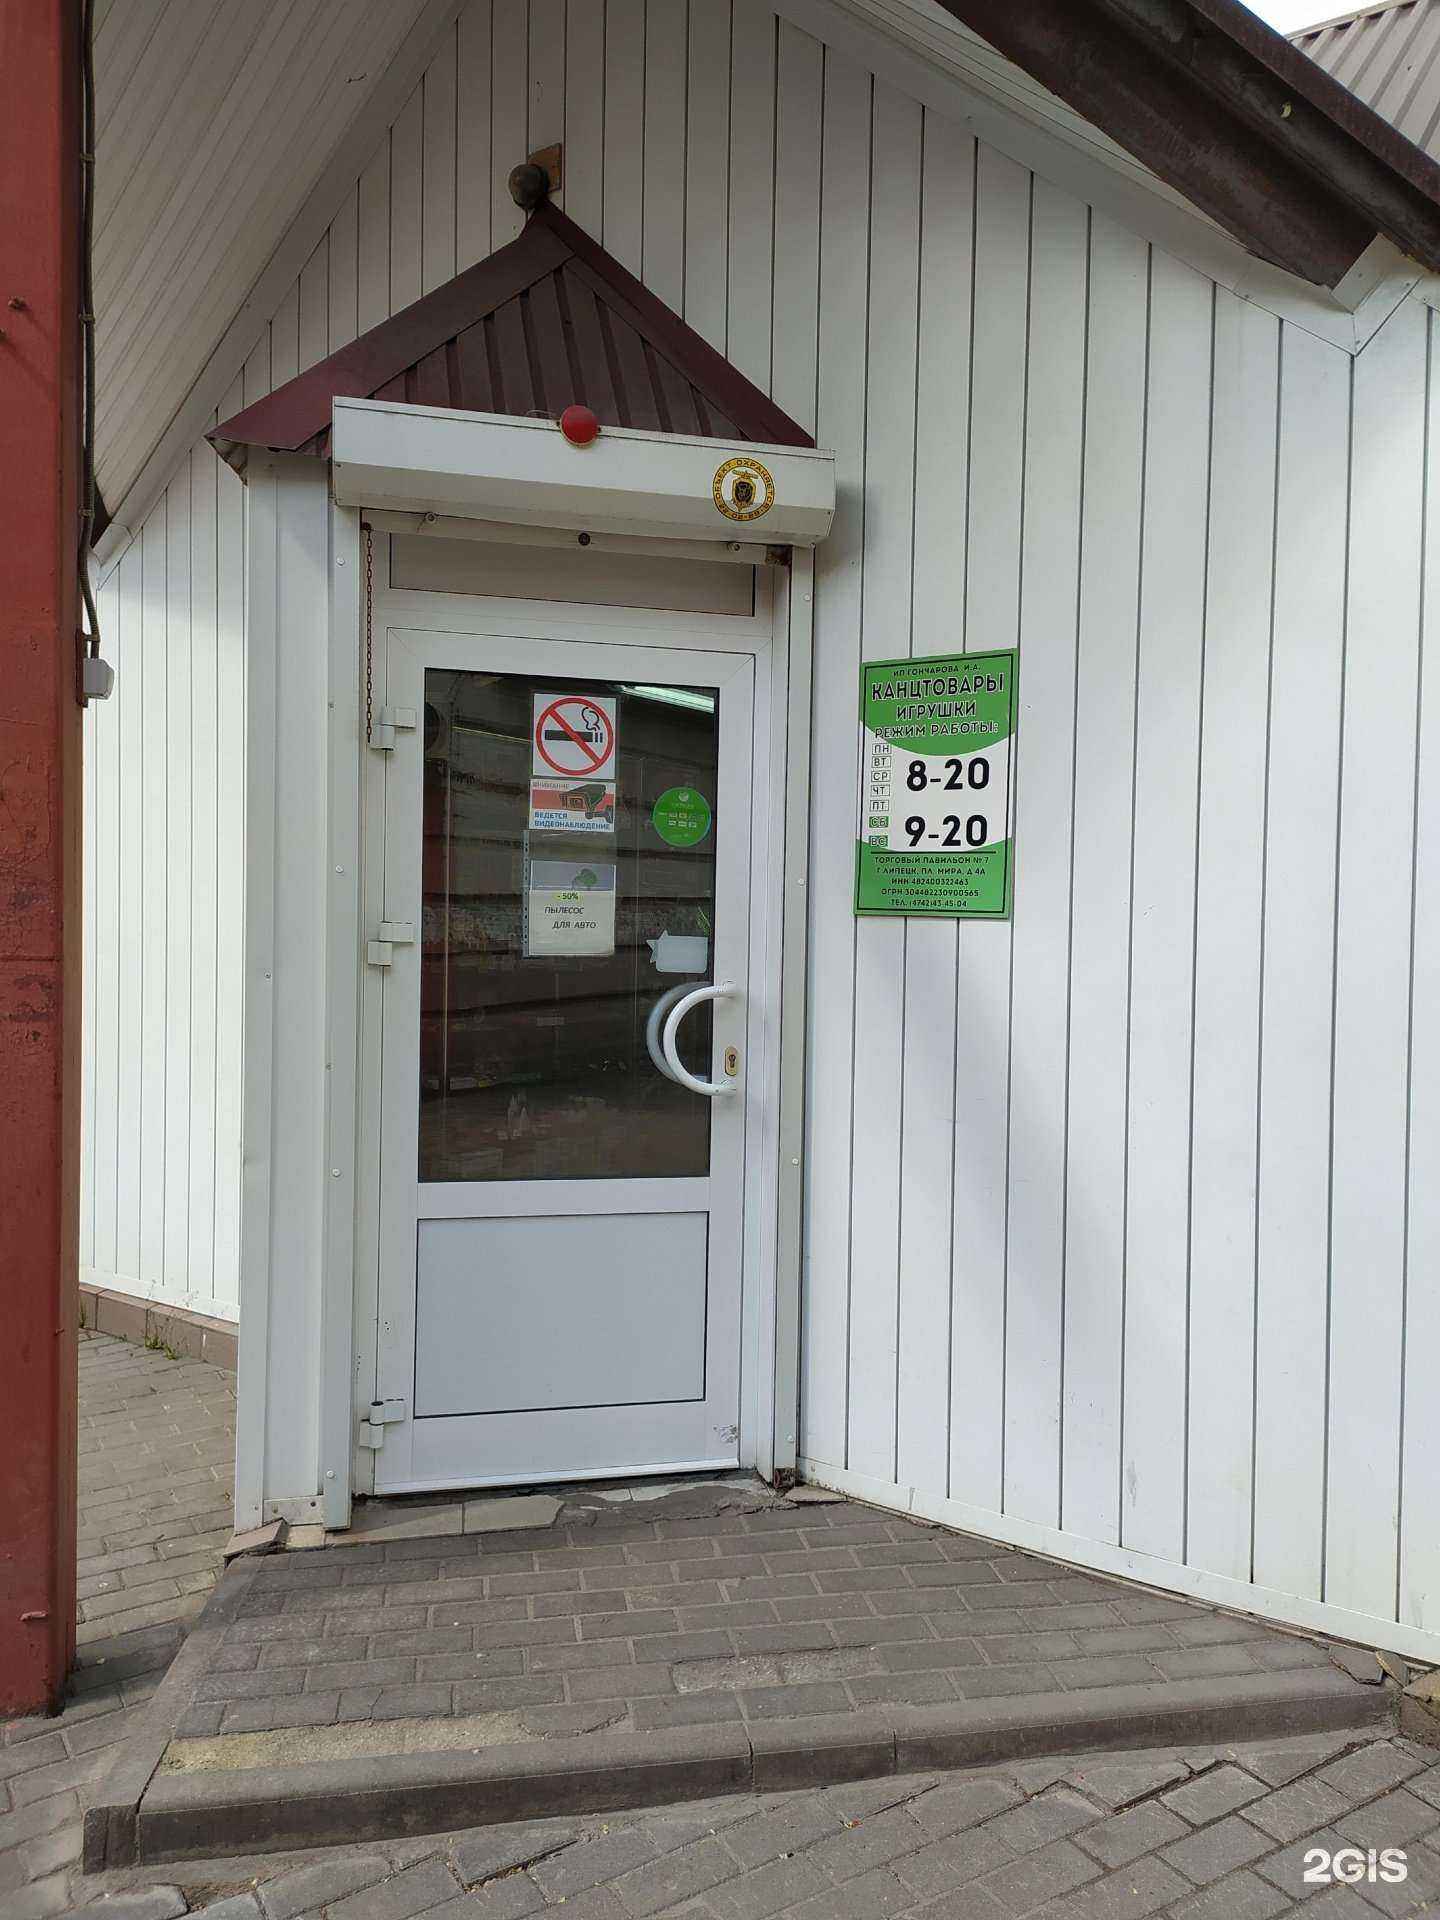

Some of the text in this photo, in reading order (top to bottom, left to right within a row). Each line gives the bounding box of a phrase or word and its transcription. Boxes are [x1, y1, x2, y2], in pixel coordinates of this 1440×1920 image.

[907, 665, 959, 676] ГОНЧАРОВА
[872, 674, 1005, 700] КАНЦТОВАРЫ
[896, 701, 976, 720] ИГРУШКИ
[875, 721, 999, 739] РЕЖИМ РАБОТЫ:
[874, 745, 890, 754] ПН
[874, 758, 886, 767] ВТ
[873, 773, 888, 781] СР
[906, 757, 990, 791] 8-20
[872, 786, 886, 795] ЧТ
[872, 801, 886, 810] ПТ
[534, 811, 568, 820] ВЕДЕТСЯ
[534, 820, 610, 830] ВИДЕОНАБЛЮДЕНИЕ
[905, 814, 988, 847] 9-20
[871, 837, 886, 846] ВС
[875, 856, 920, 864] ТОРГОВЫЙ
[923, 856, 971, 864] ПАВИЛЬОН
[544, 906, 585, 914] ПЫЛЕСОС
[552, 921, 597, 930] ДЛЯ АВТО
